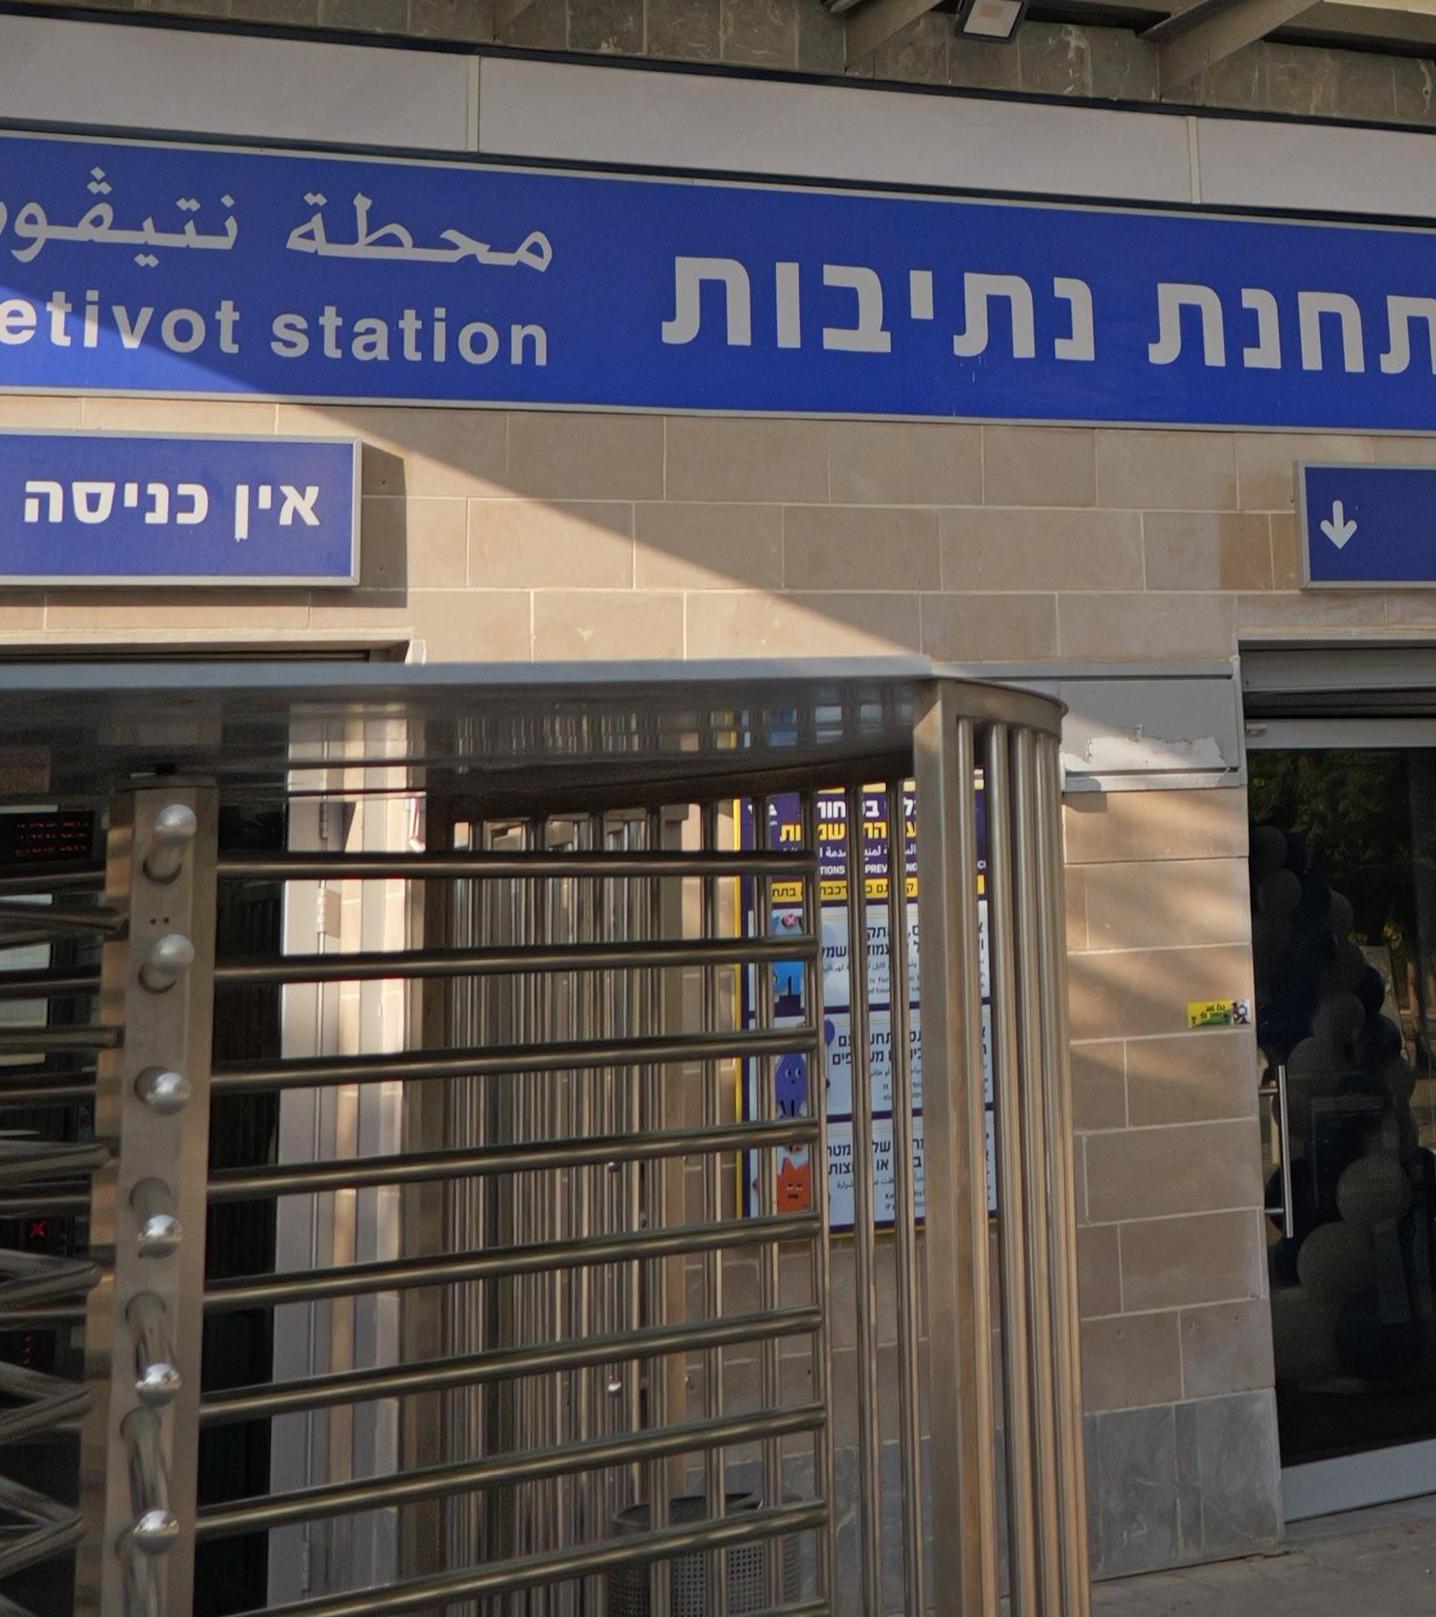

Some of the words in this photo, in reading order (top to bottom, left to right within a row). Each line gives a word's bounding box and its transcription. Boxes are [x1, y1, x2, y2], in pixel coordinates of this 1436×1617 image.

[0, 166, 239, 268] نتيڤو
[285, 193, 553, 272] محطة
[0, 289, 241, 354] etivot
[270, 305, 548, 367] station
[661, 255, 1096, 362] נתיבות
[24, 480, 209, 525] כניסה
[234, 484, 321, 543] אין
